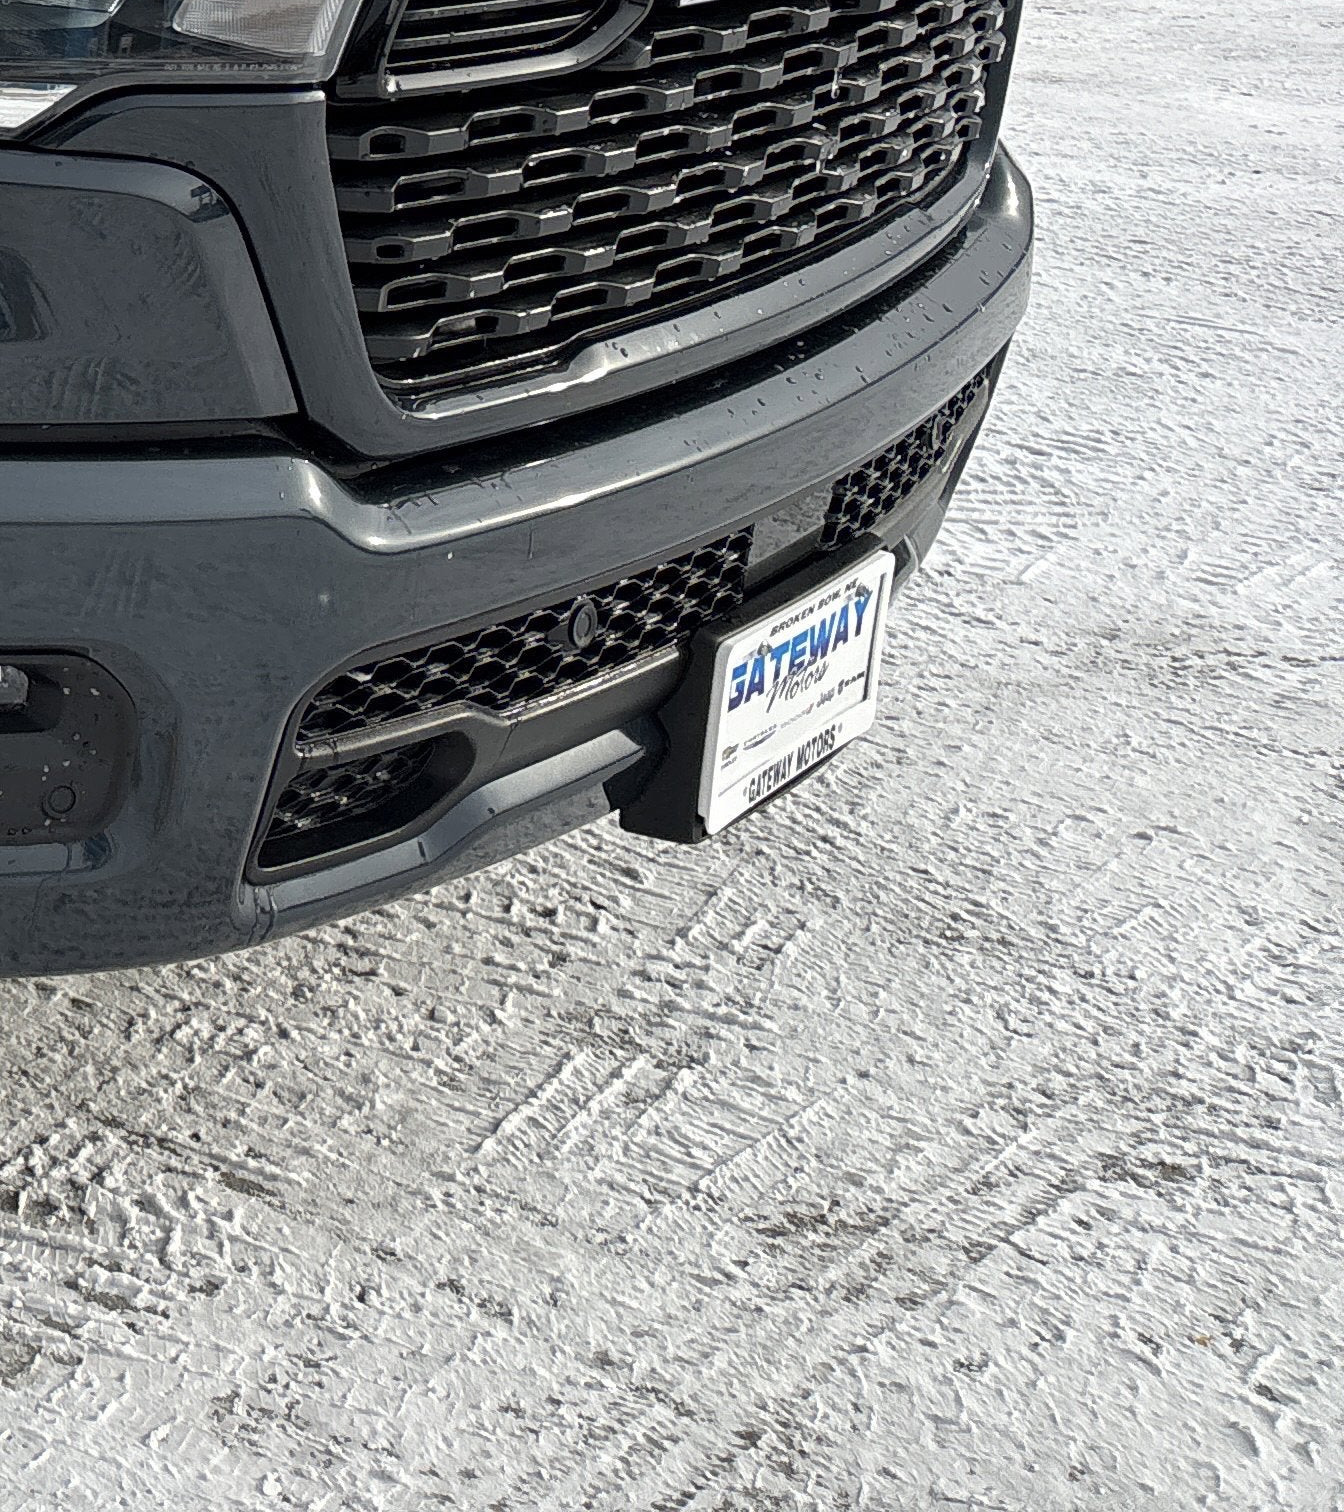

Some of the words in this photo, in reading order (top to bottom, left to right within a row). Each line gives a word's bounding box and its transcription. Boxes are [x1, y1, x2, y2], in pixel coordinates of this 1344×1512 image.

[727, 589, 874, 713] GATEWAY
[770, 604, 815, 637] BROKEN
[765, 657, 830, 714] Motors
[748, 751, 794, 804] GATEWAY
[796, 724, 836, 772] MOTORS
